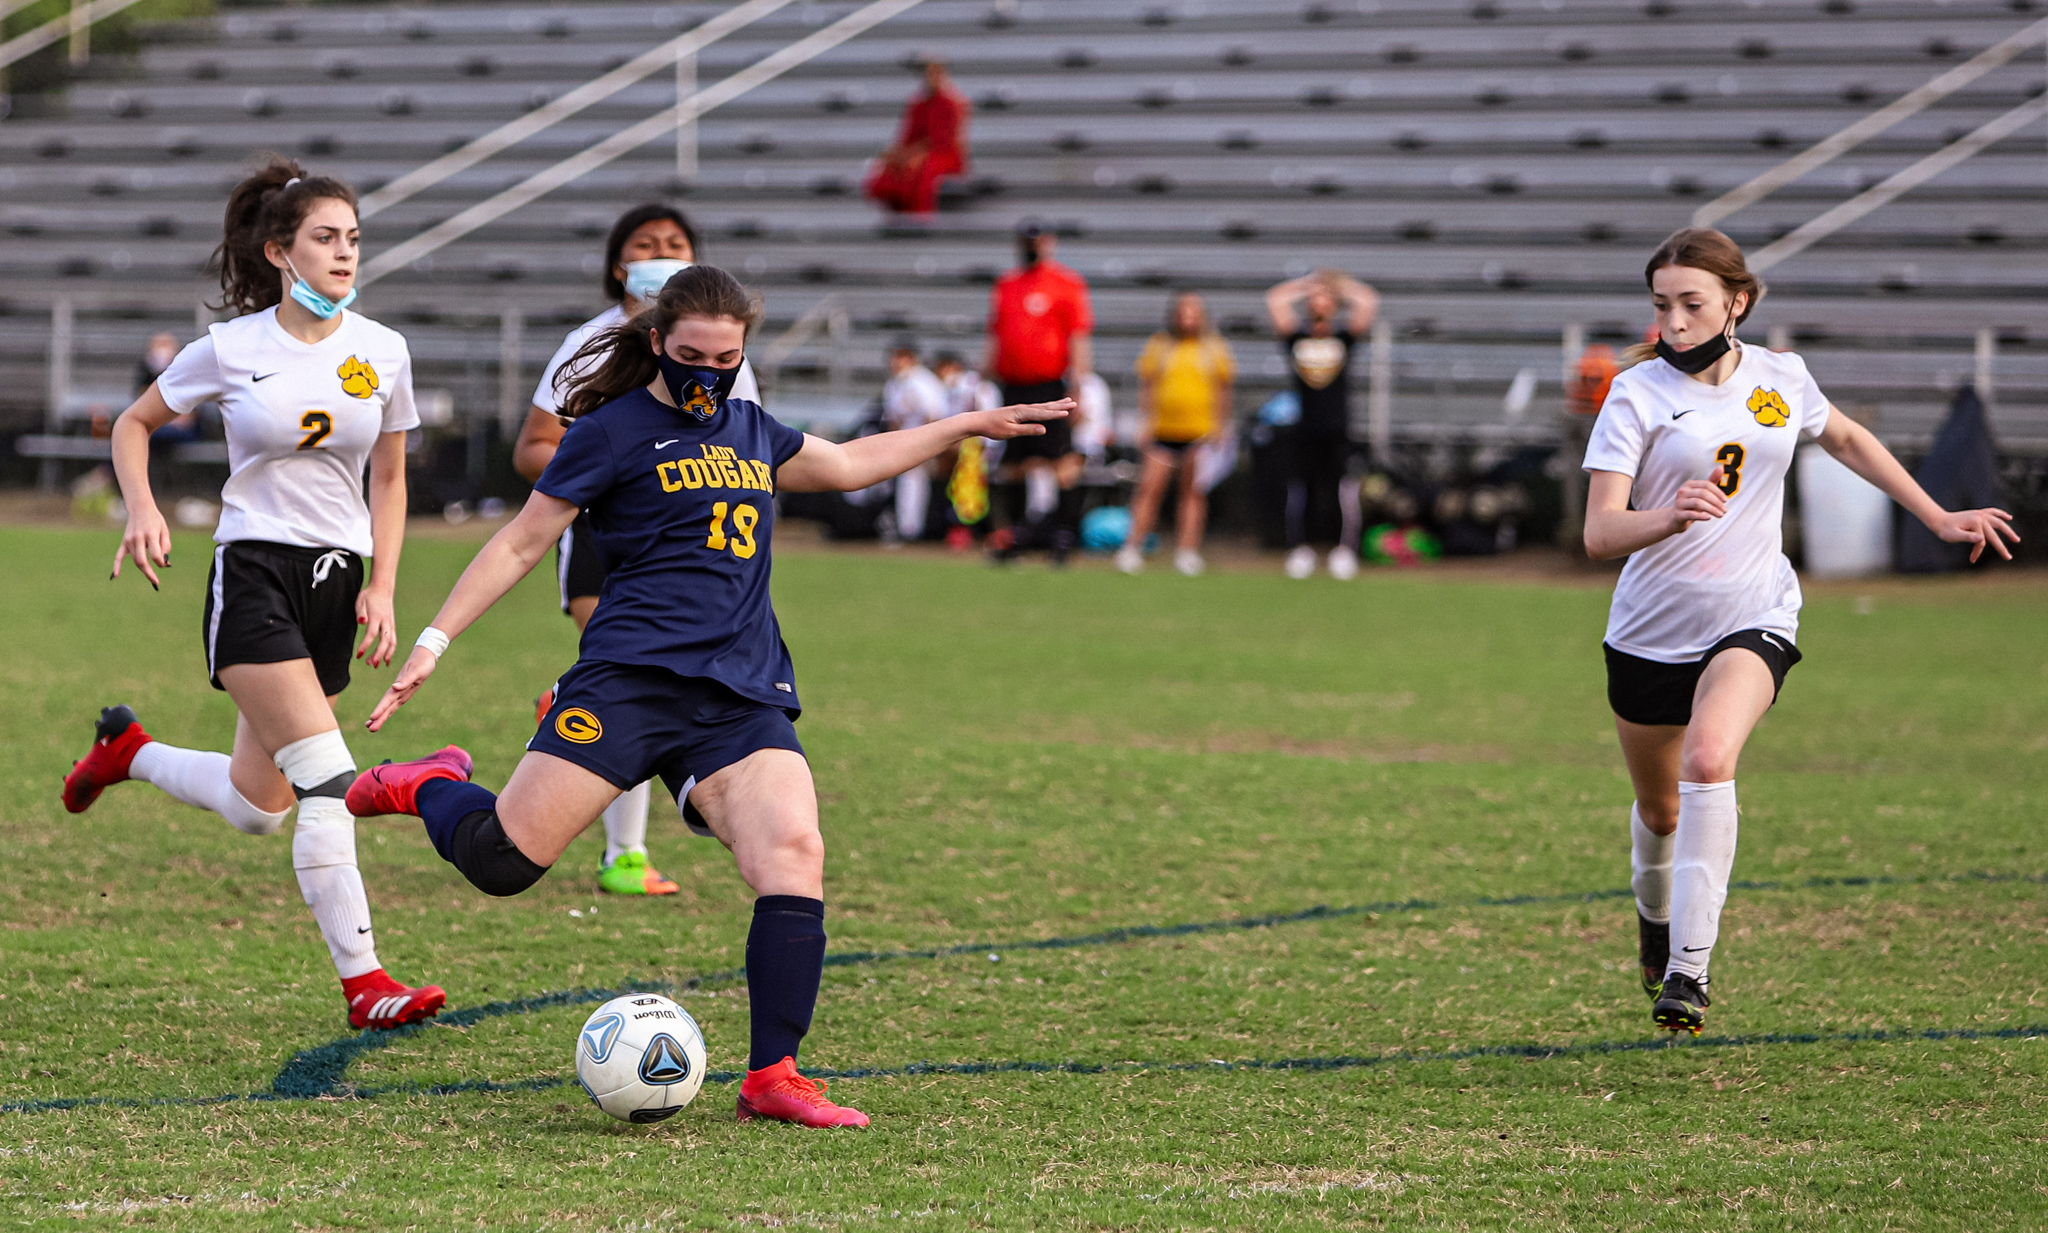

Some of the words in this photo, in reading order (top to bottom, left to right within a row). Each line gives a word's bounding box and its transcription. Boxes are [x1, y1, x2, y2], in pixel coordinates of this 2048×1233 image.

[296, 410, 333, 451] 2
[700, 443, 738, 461] LADY
[1715, 442, 1747, 499] 3
[706, 501, 759, 560] 19
[556, 708, 601, 743] G
[632, 1010, 677, 1020] Wilson
